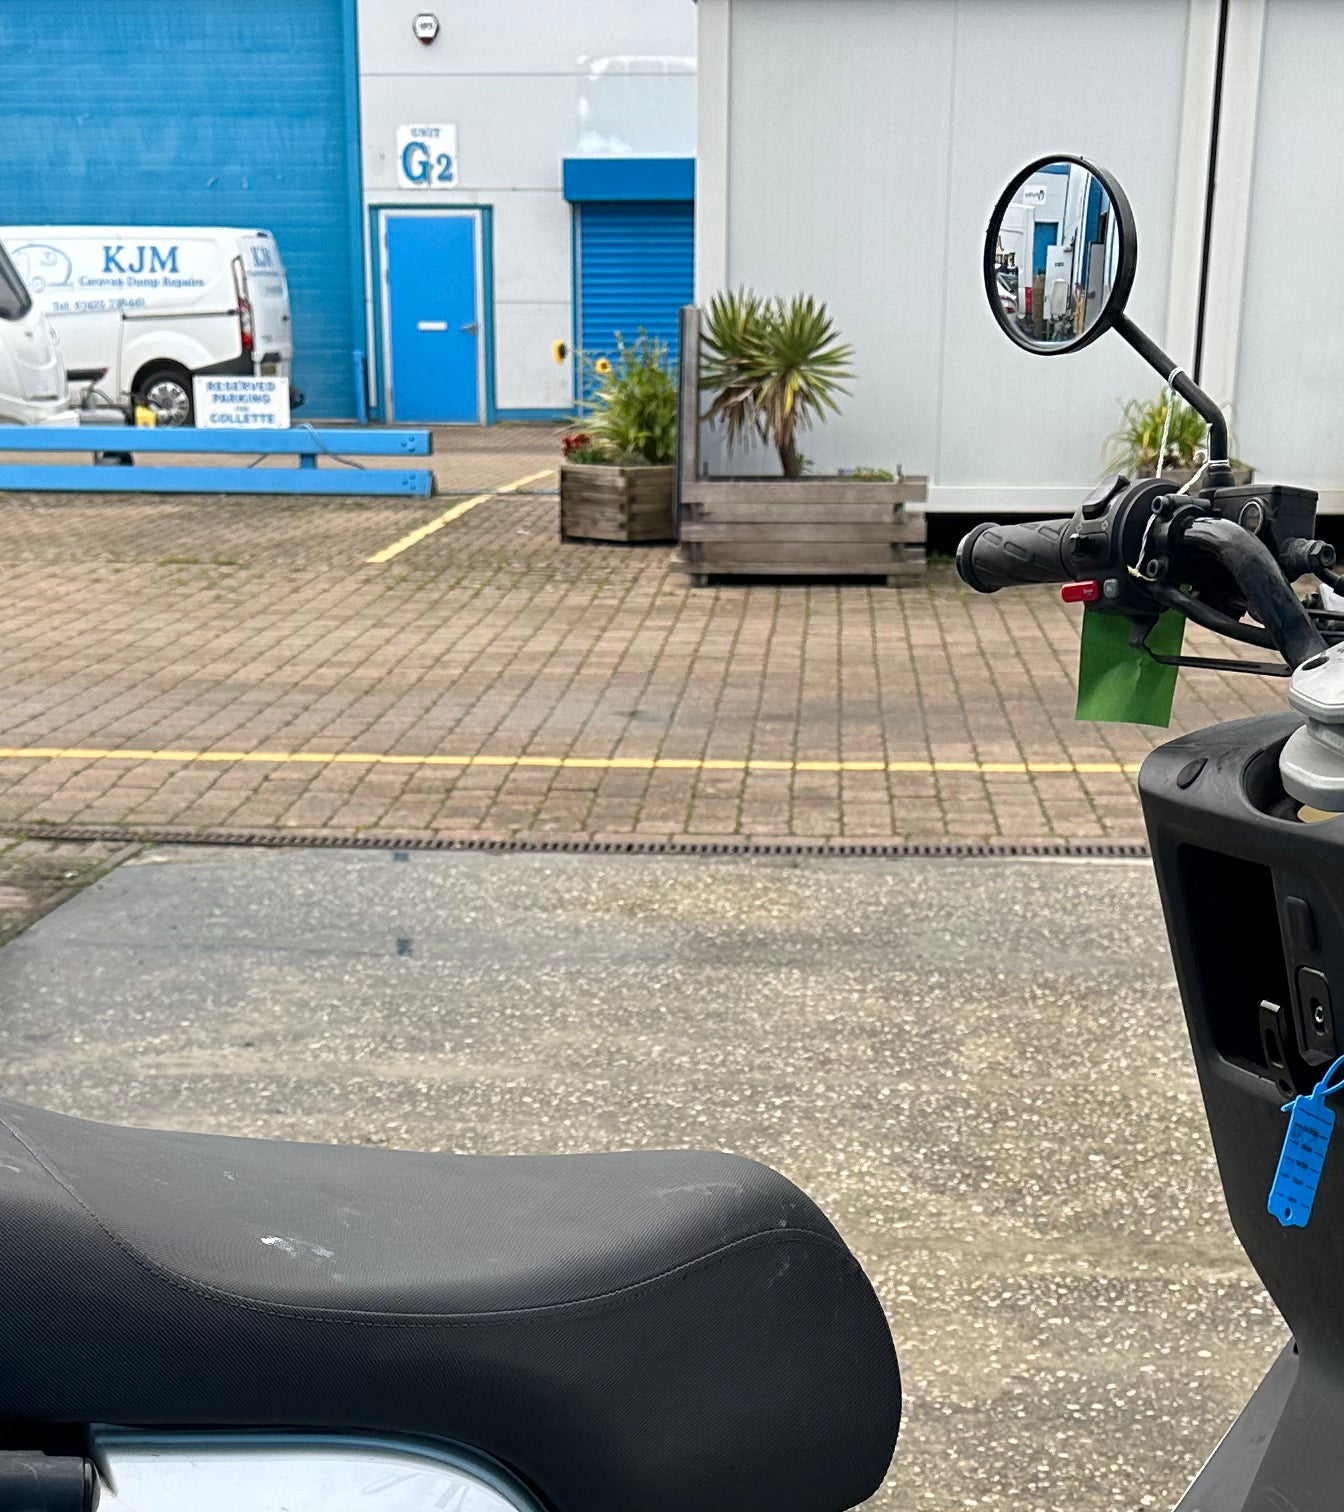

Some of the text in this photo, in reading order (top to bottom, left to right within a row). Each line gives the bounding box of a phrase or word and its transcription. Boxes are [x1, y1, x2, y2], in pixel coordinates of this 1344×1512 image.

[401, 140, 454, 183] G2
[102, 245, 180, 274] KJM
[206, 381, 276, 392] RESERVED
[211, 393, 272, 405] PARKING
[209, 413, 275, 425] COLLETTE
